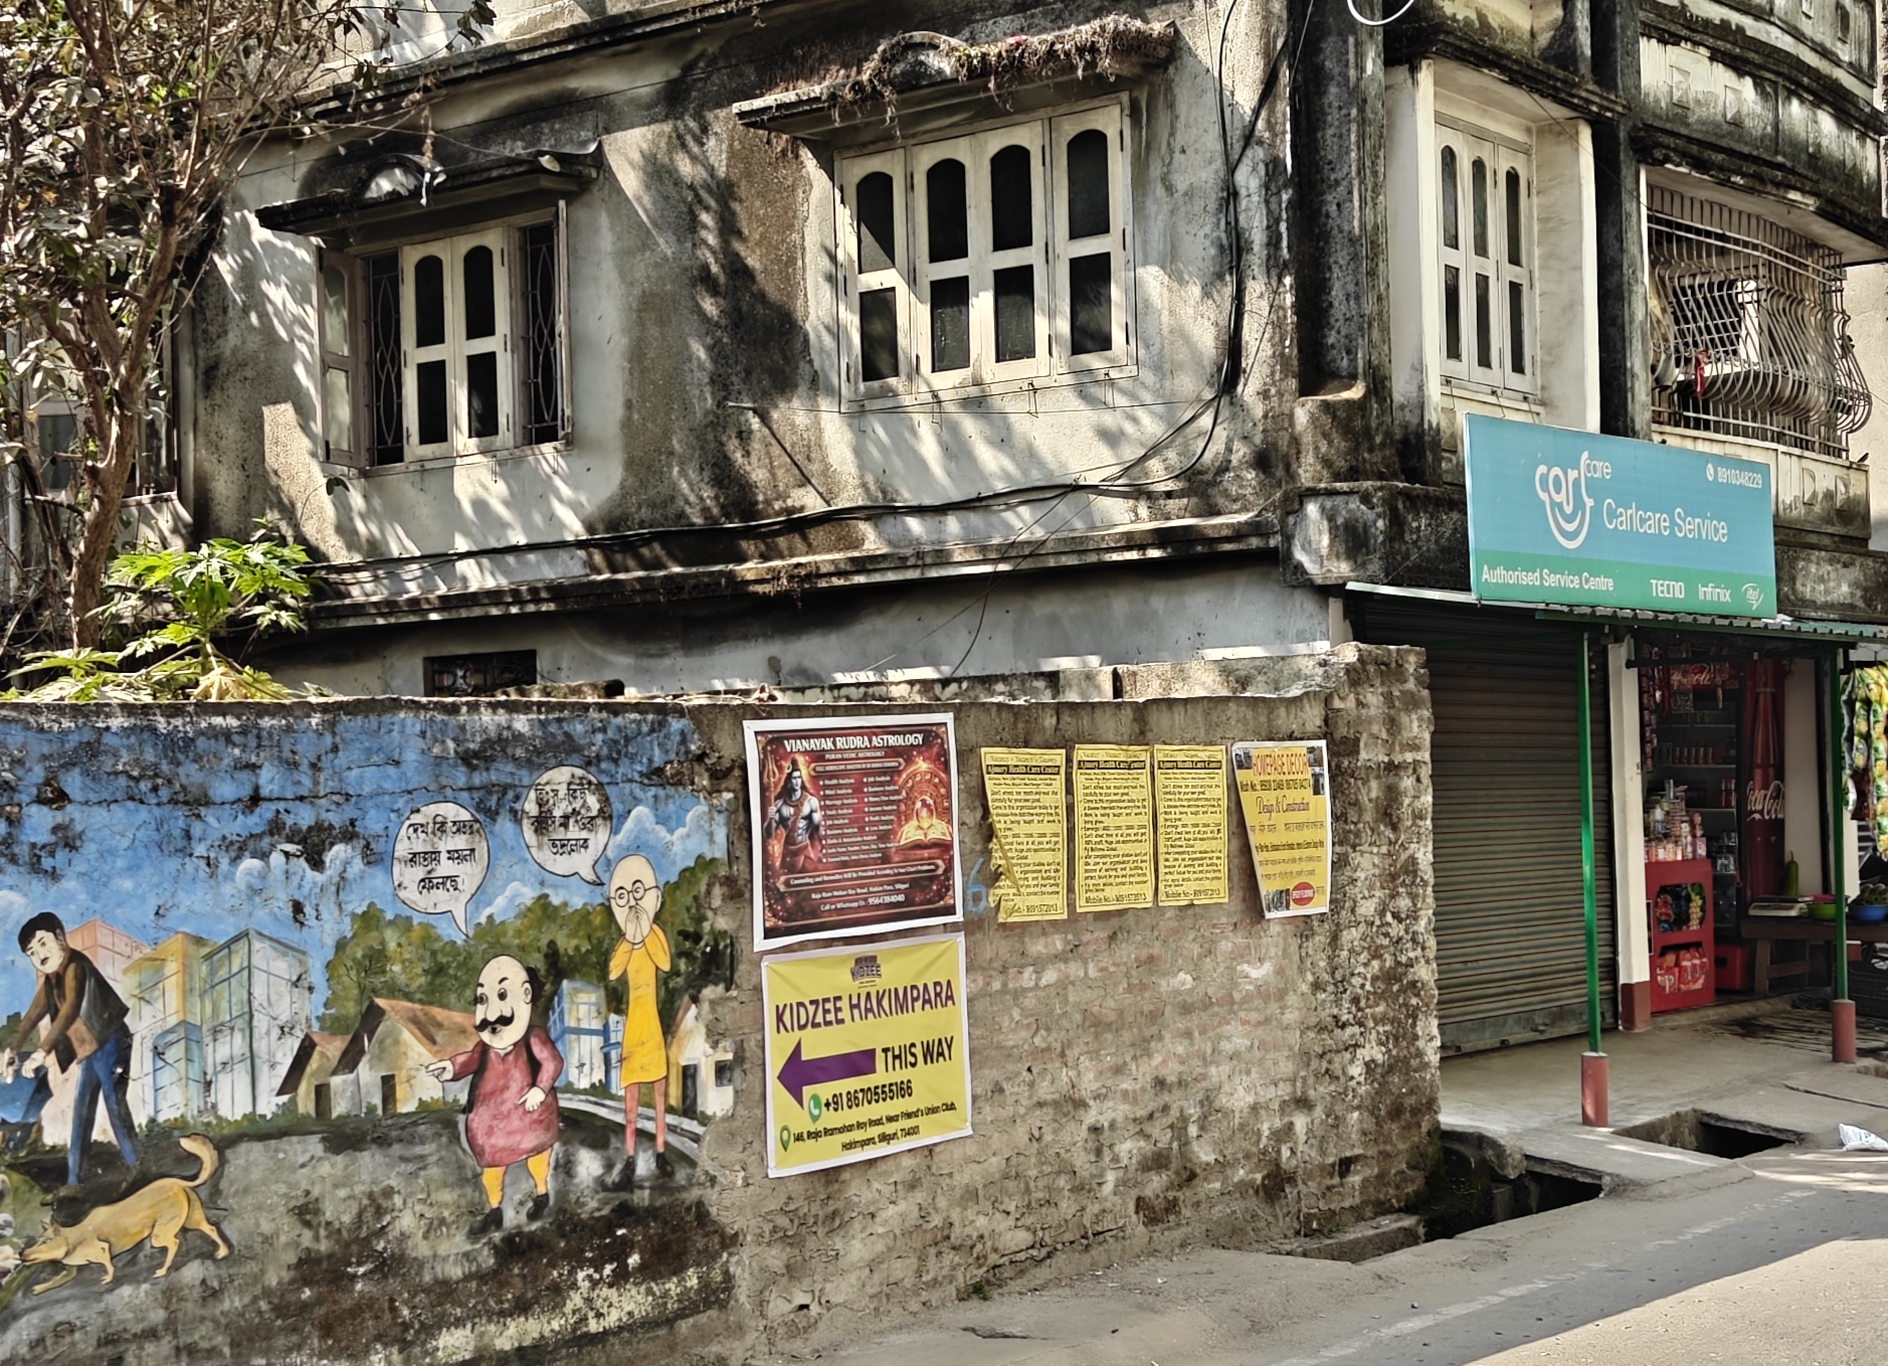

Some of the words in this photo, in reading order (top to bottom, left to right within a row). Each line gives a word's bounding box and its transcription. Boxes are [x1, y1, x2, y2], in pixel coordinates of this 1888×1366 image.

[1584, 457, 1612, 480] care
[1603, 498, 1670, 536] Carlcare
[1675, 507, 1728, 543] Service
[1481, 564, 1541, 586] Authorised
[1543, 568, 1580, 589] Service
[1582, 573, 1614, 592] Centre
[1650, 579, 1684, 598] TECNO
[1698, 583, 1731, 603] Infinix
[784, 737, 834, 752] VIANAYAK
[836, 736, 870, 750] RUDRA
[871, 733, 924, 748] ASTROLOGY
[406, 821, 429, 841] দেখ
[431, 814, 448, 841] কি
[776, 995, 845, 1034] KIDZEE
[849, 979, 955, 1023] HAKIMPARA
[882, 1042, 918, 1072] THIS
[921, 1036, 954, 1065] WAY
[824, 1092, 844, 1112] +91
[846, 1079, 913, 1110] 8670555166
[807, 1128, 822, 1142] Raja
[856, 1120, 867, 1132] Roy
[885, 1114, 899, 1124] Near
[925, 1104, 941, 1116] Union
